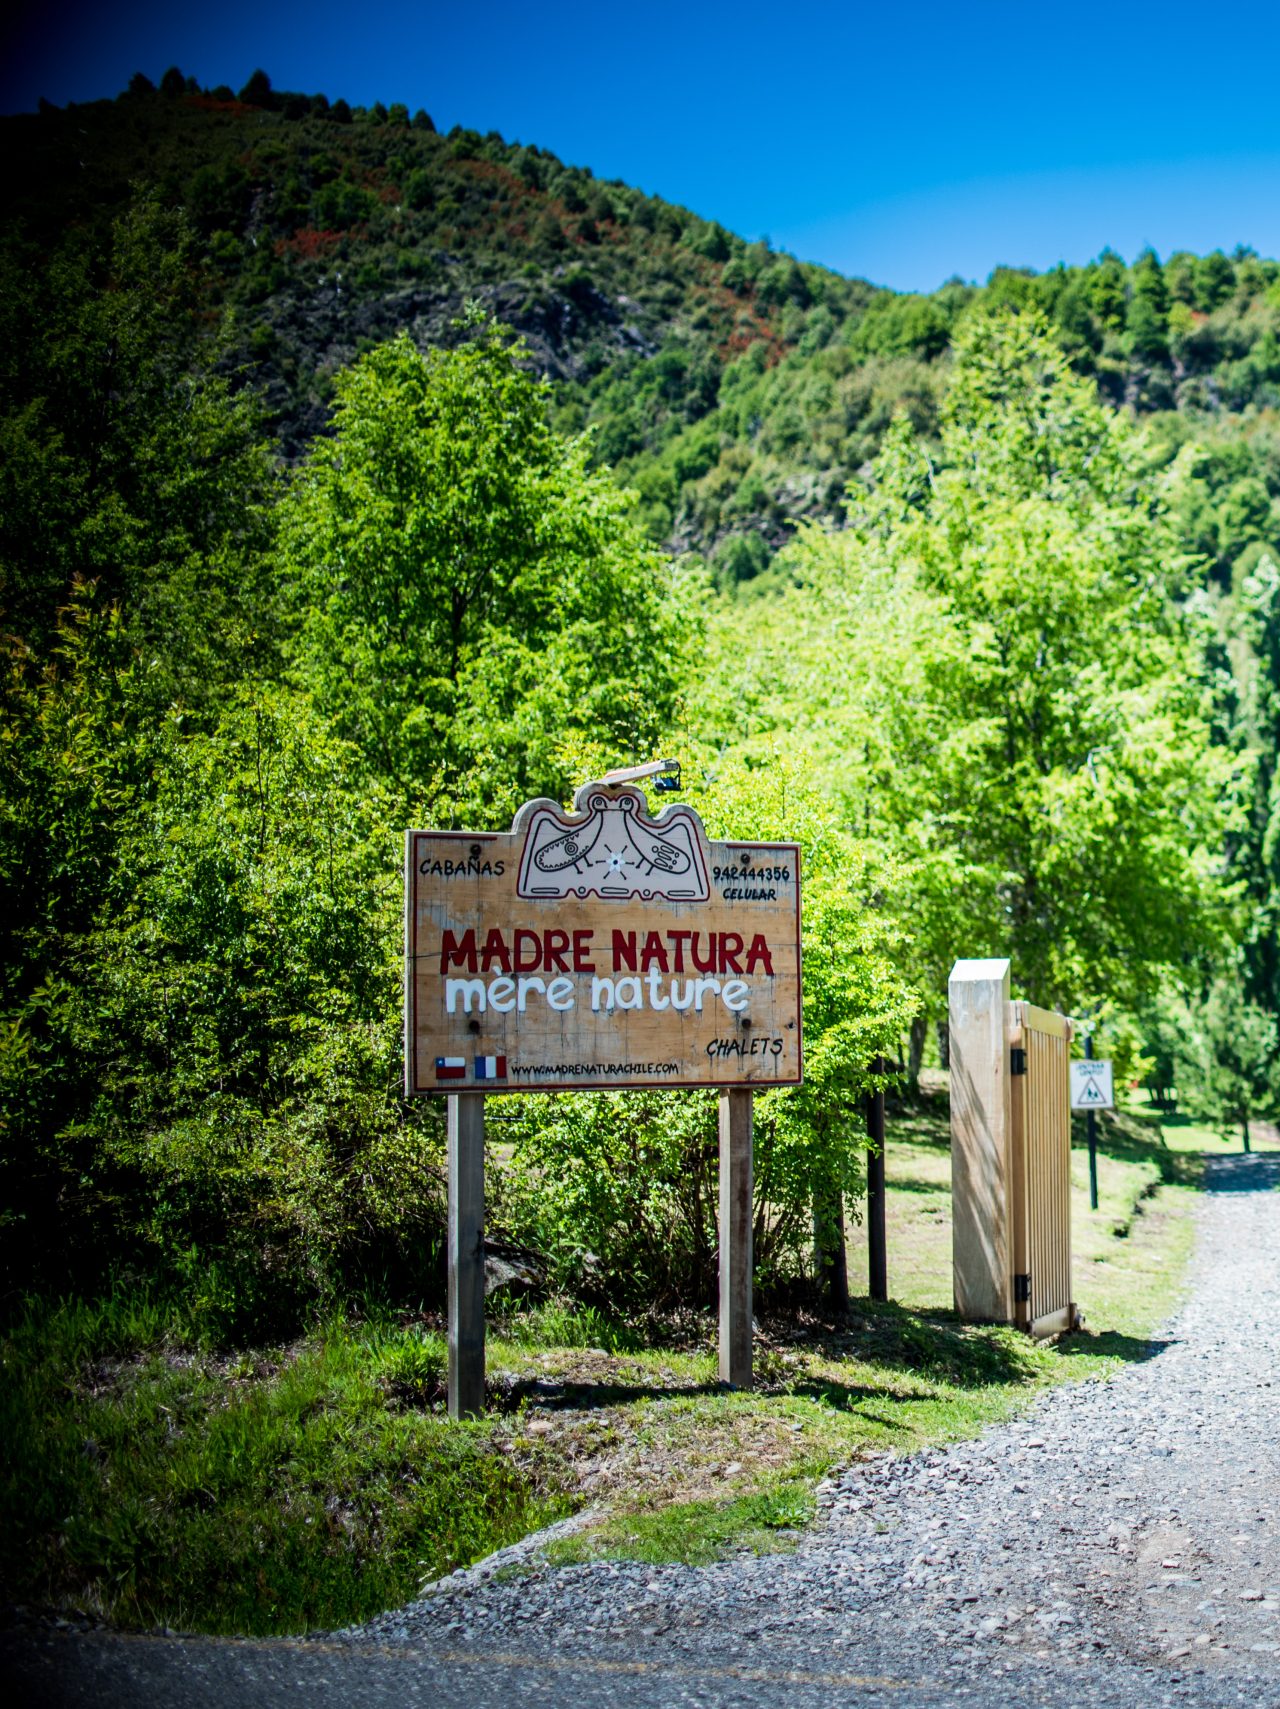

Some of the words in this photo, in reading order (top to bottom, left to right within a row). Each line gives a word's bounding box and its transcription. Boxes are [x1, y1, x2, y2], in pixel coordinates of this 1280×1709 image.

[419, 856, 505, 876] CABAÑAS
[722, 888, 777, 901] CELULAR
[440, 929, 596, 974] MADRE
[611, 929, 774, 976] NATURA
[445, 966, 575, 1013] mère
[591, 966, 750, 1012] nature
[706, 1038, 783, 1057] CHALETS
